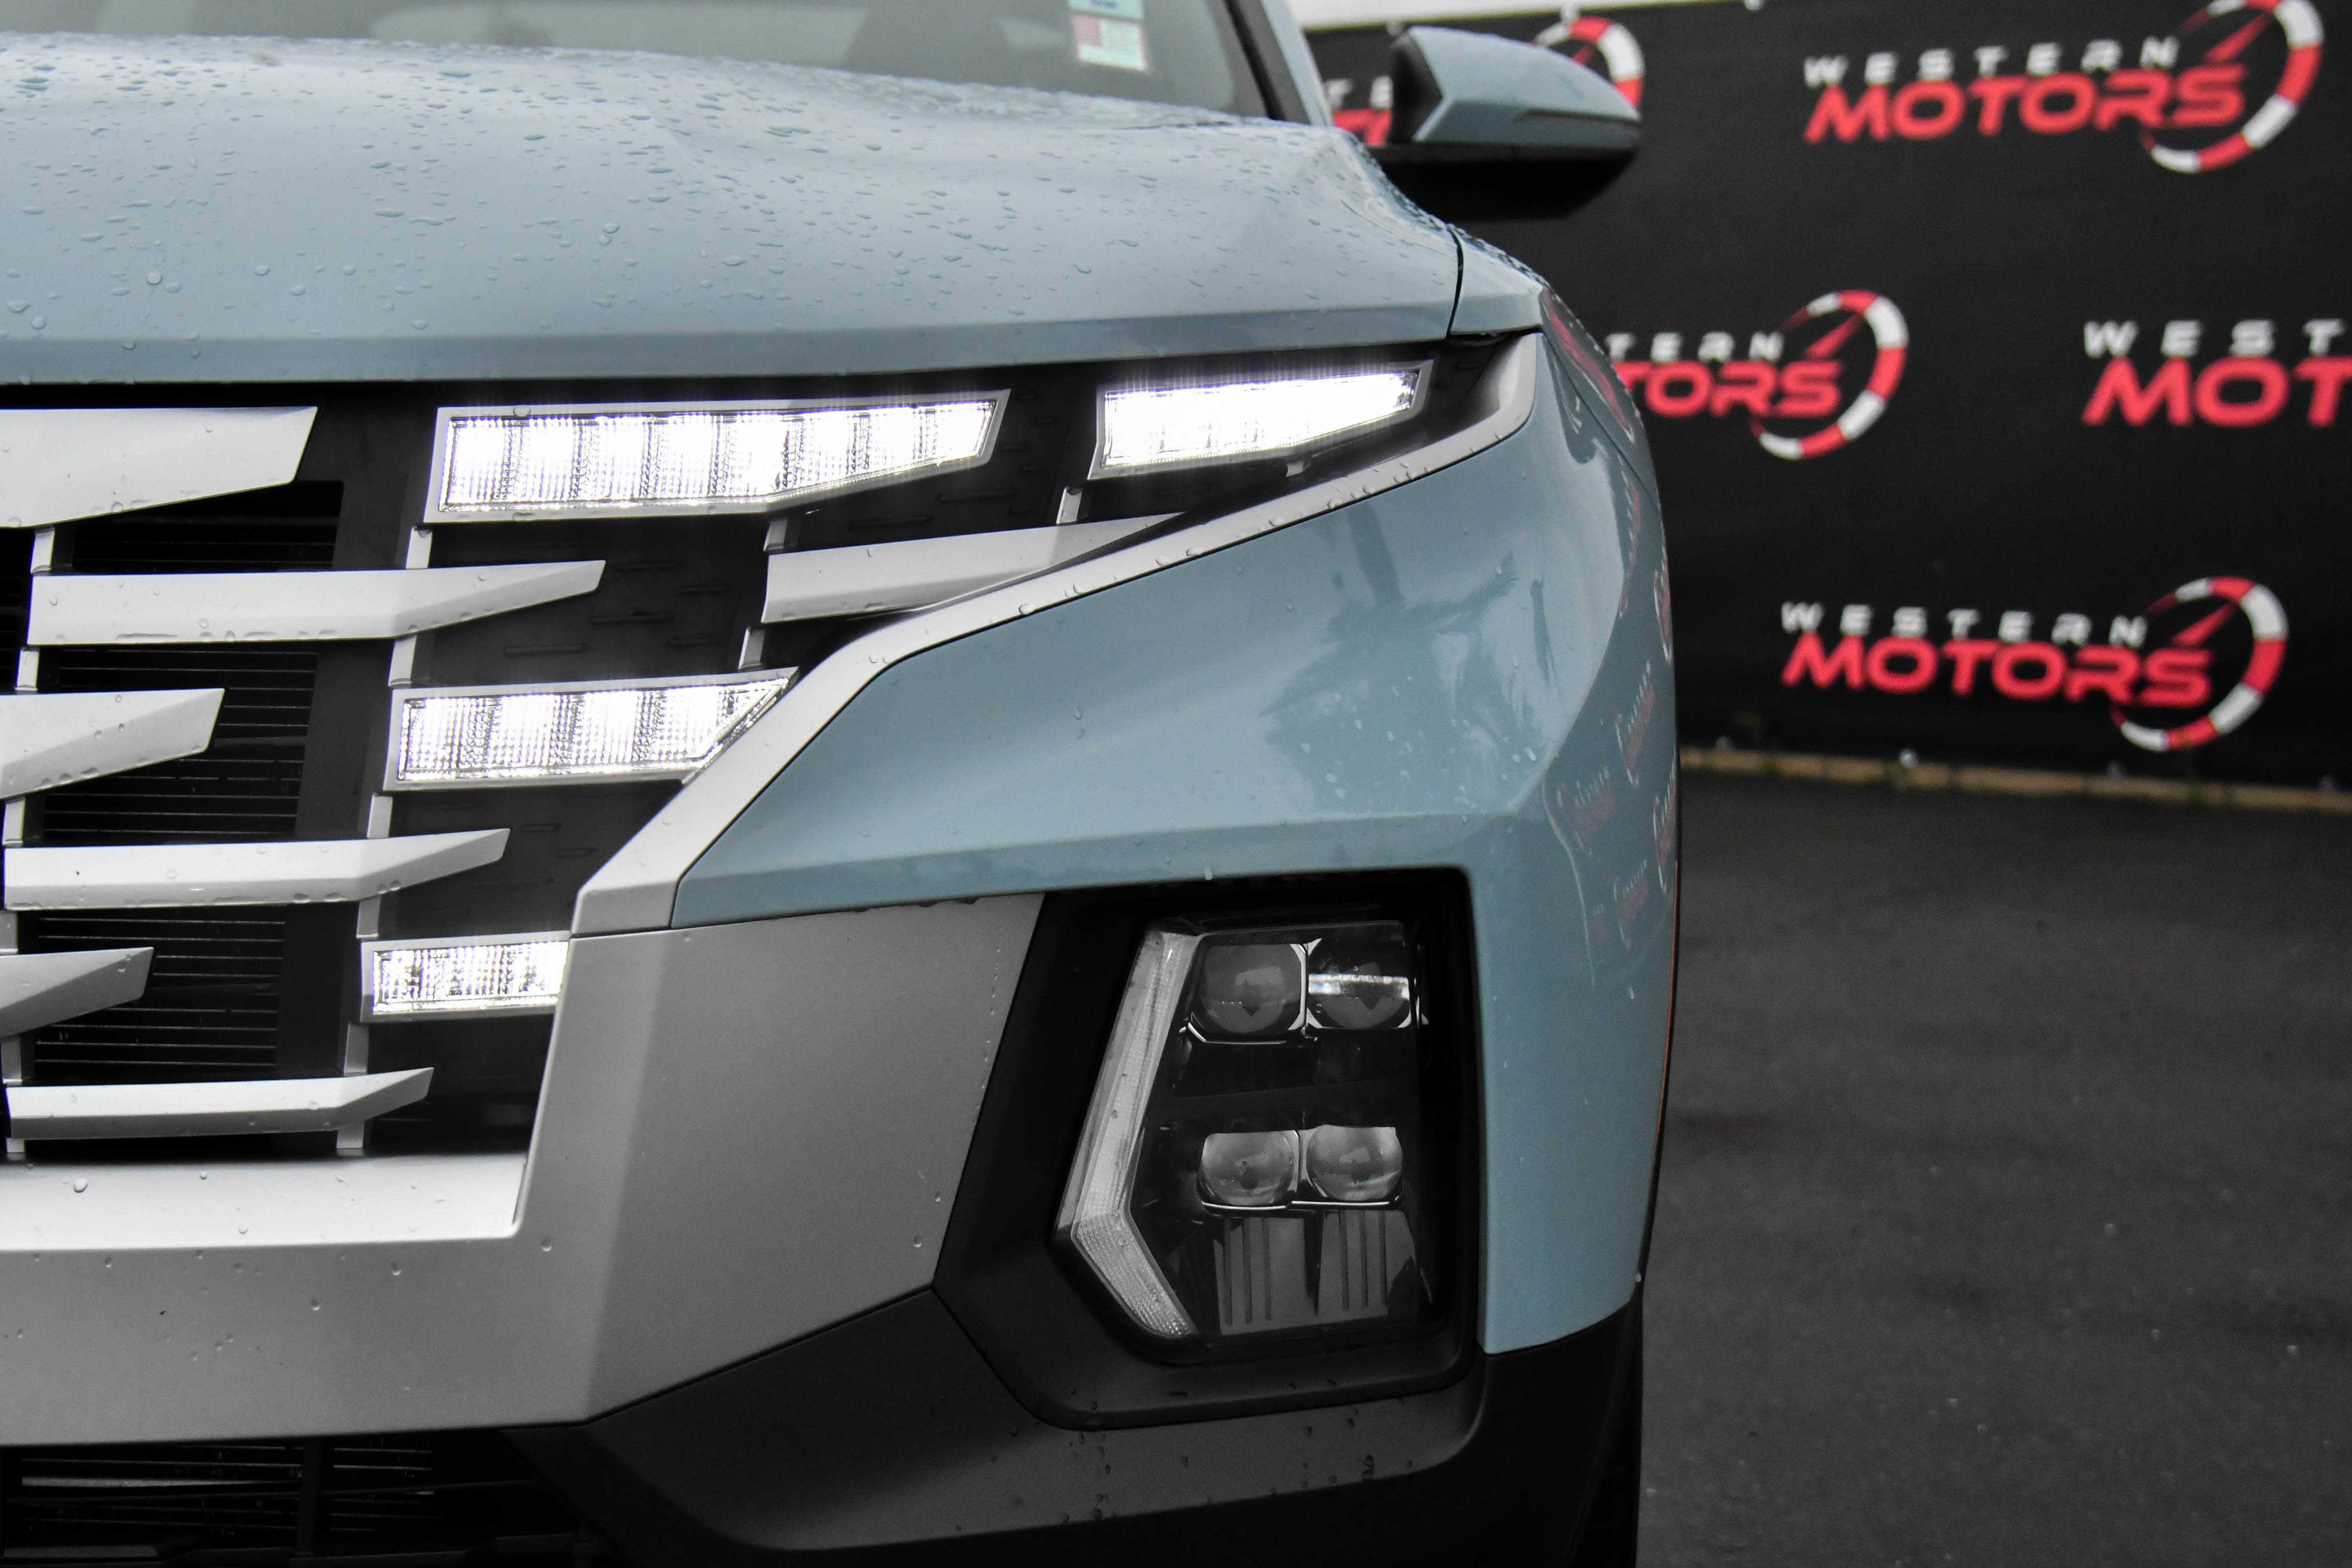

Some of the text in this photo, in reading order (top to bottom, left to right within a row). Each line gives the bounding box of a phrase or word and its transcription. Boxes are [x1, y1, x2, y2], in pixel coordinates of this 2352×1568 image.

[1802, 35, 2180, 90] WESTERN
[1803, 63, 2246, 144] MOTORS
[1604, 331, 1785, 365] TERN
[2083, 319, 2345, 359] WEST
[2082, 355, 2352, 427] MOT
[1780, 602, 2147, 648] WESTERN
[1781, 631, 2212, 707] MOTORS
